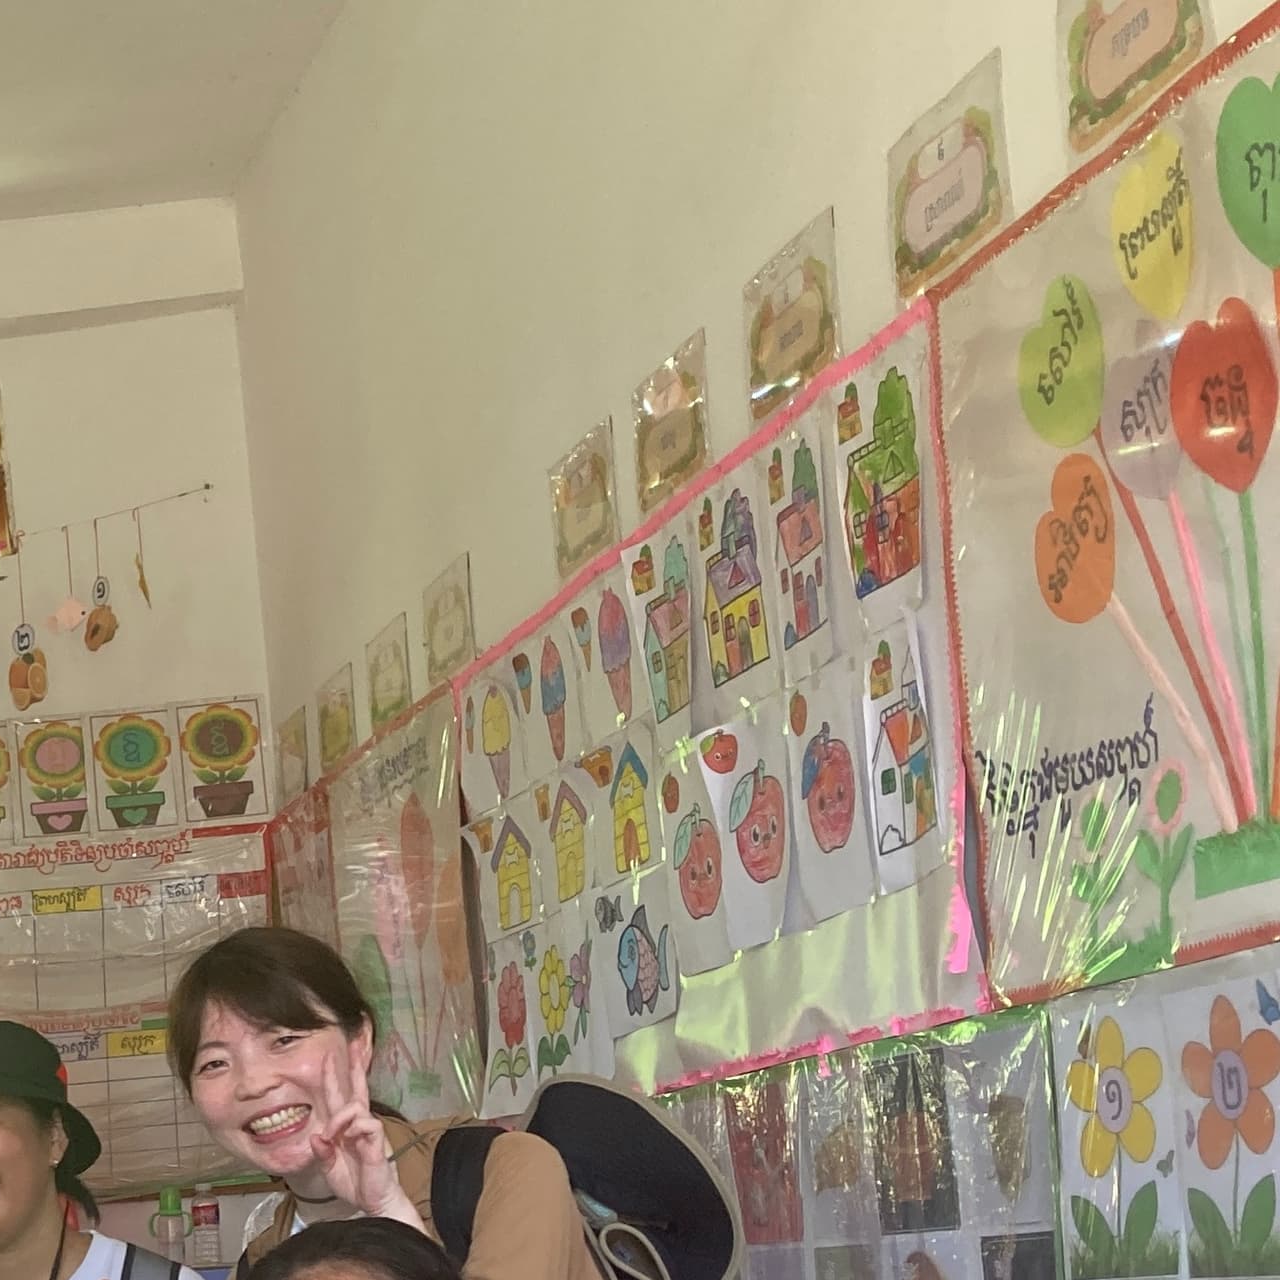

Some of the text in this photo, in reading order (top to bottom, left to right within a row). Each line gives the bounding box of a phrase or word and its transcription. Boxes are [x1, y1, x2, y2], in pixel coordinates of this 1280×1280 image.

[95, 581, 107, 602] ១
[15, 627, 32, 651] ២
[1103, 1078, 1123, 1121] ១
